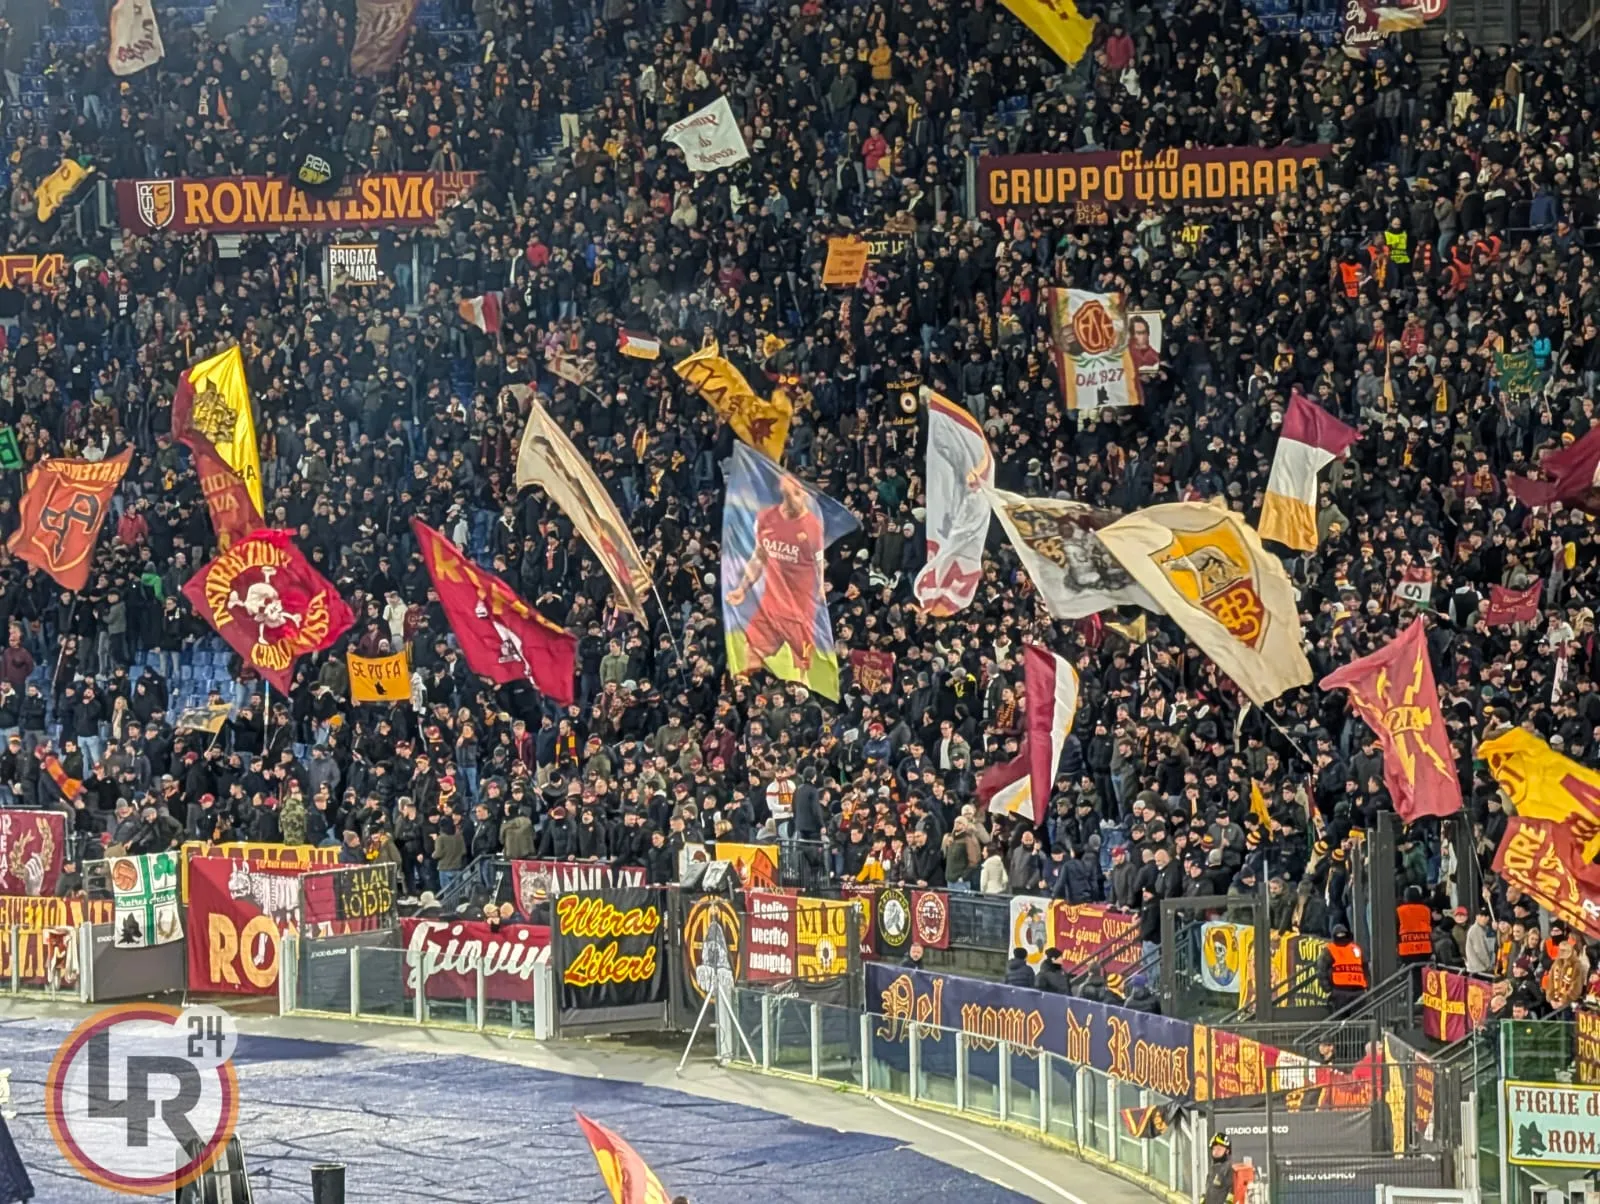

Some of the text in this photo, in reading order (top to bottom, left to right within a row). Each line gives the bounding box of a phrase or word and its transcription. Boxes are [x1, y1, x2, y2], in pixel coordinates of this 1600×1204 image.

[989, 165, 1124, 205] GRUPPO
[330, 249, 378, 265] BRIGATA
[762, 537, 799, 555] QATAR
[351, 661, 368, 679] SE
[556, 894, 660, 938] Ultras
[208, 912, 290, 989] RO
[563, 940, 657, 987] Liberi
[877, 975, 943, 1044] Nel
[961, 1003, 1045, 1060] nome
[1066, 1007, 1092, 1066] di
[1107, 1015, 1190, 1097] Roma
[1515, 1089, 1580, 1116] FIGLIE
[1225, 1125, 1289, 1135] STADIO OLIICO
[1547, 1129, 1600, 1156] ROM
